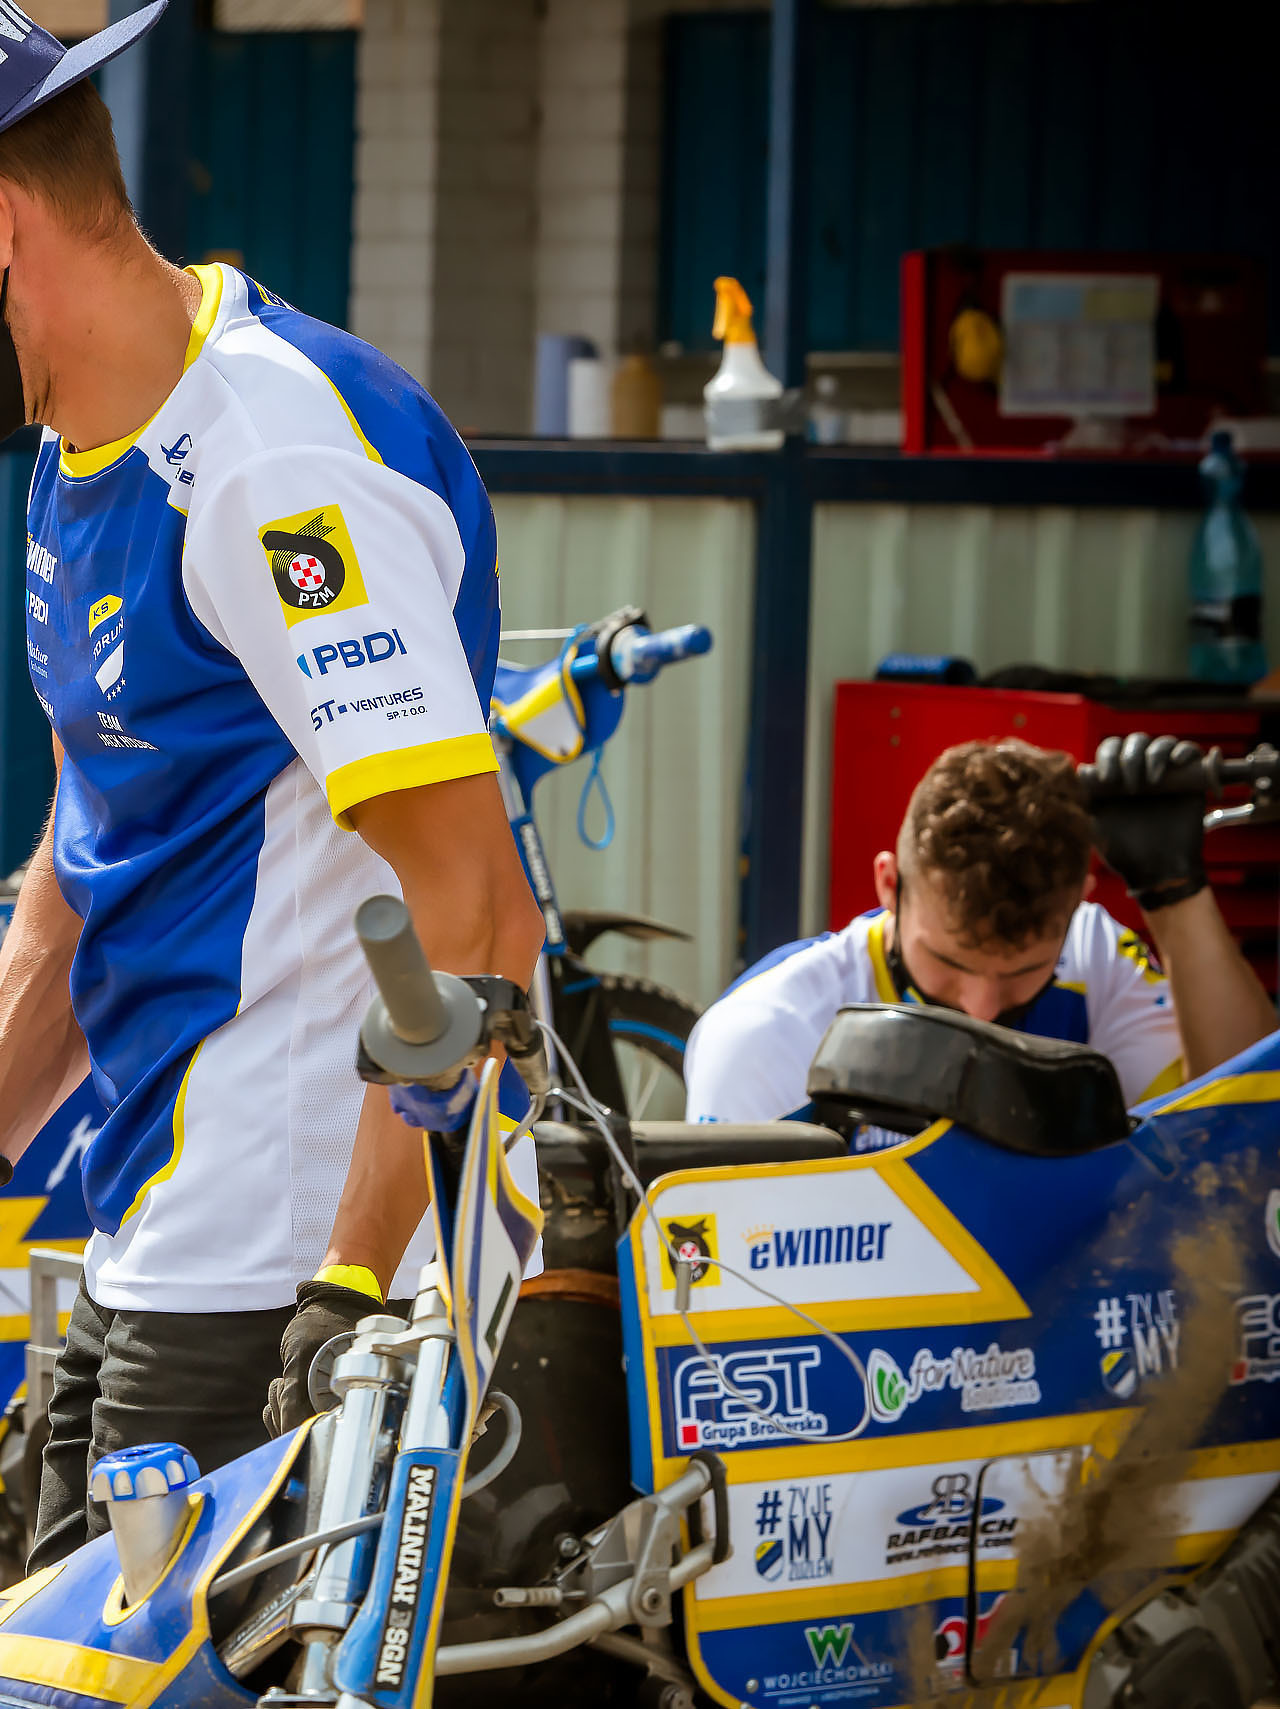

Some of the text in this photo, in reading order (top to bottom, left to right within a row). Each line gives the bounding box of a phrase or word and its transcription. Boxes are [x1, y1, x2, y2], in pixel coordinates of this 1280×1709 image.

[29, 591, 49, 625] PBDI
[93, 602, 109, 620] KS
[298, 585, 336, 607] PZM
[311, 628, 408, 676] PBDI
[349, 687, 424, 713] VENTURES
[96, 711, 124, 732] TEAM
[386, 711, 401, 721] SP.
[750, 1221, 893, 1271] eWinner
[1132, 1323, 1180, 1376] MY
[674, 1344, 821, 1425] FST
[702, 1422, 746, 1444] Grupa
[788, 1511, 832, 1561] MY
